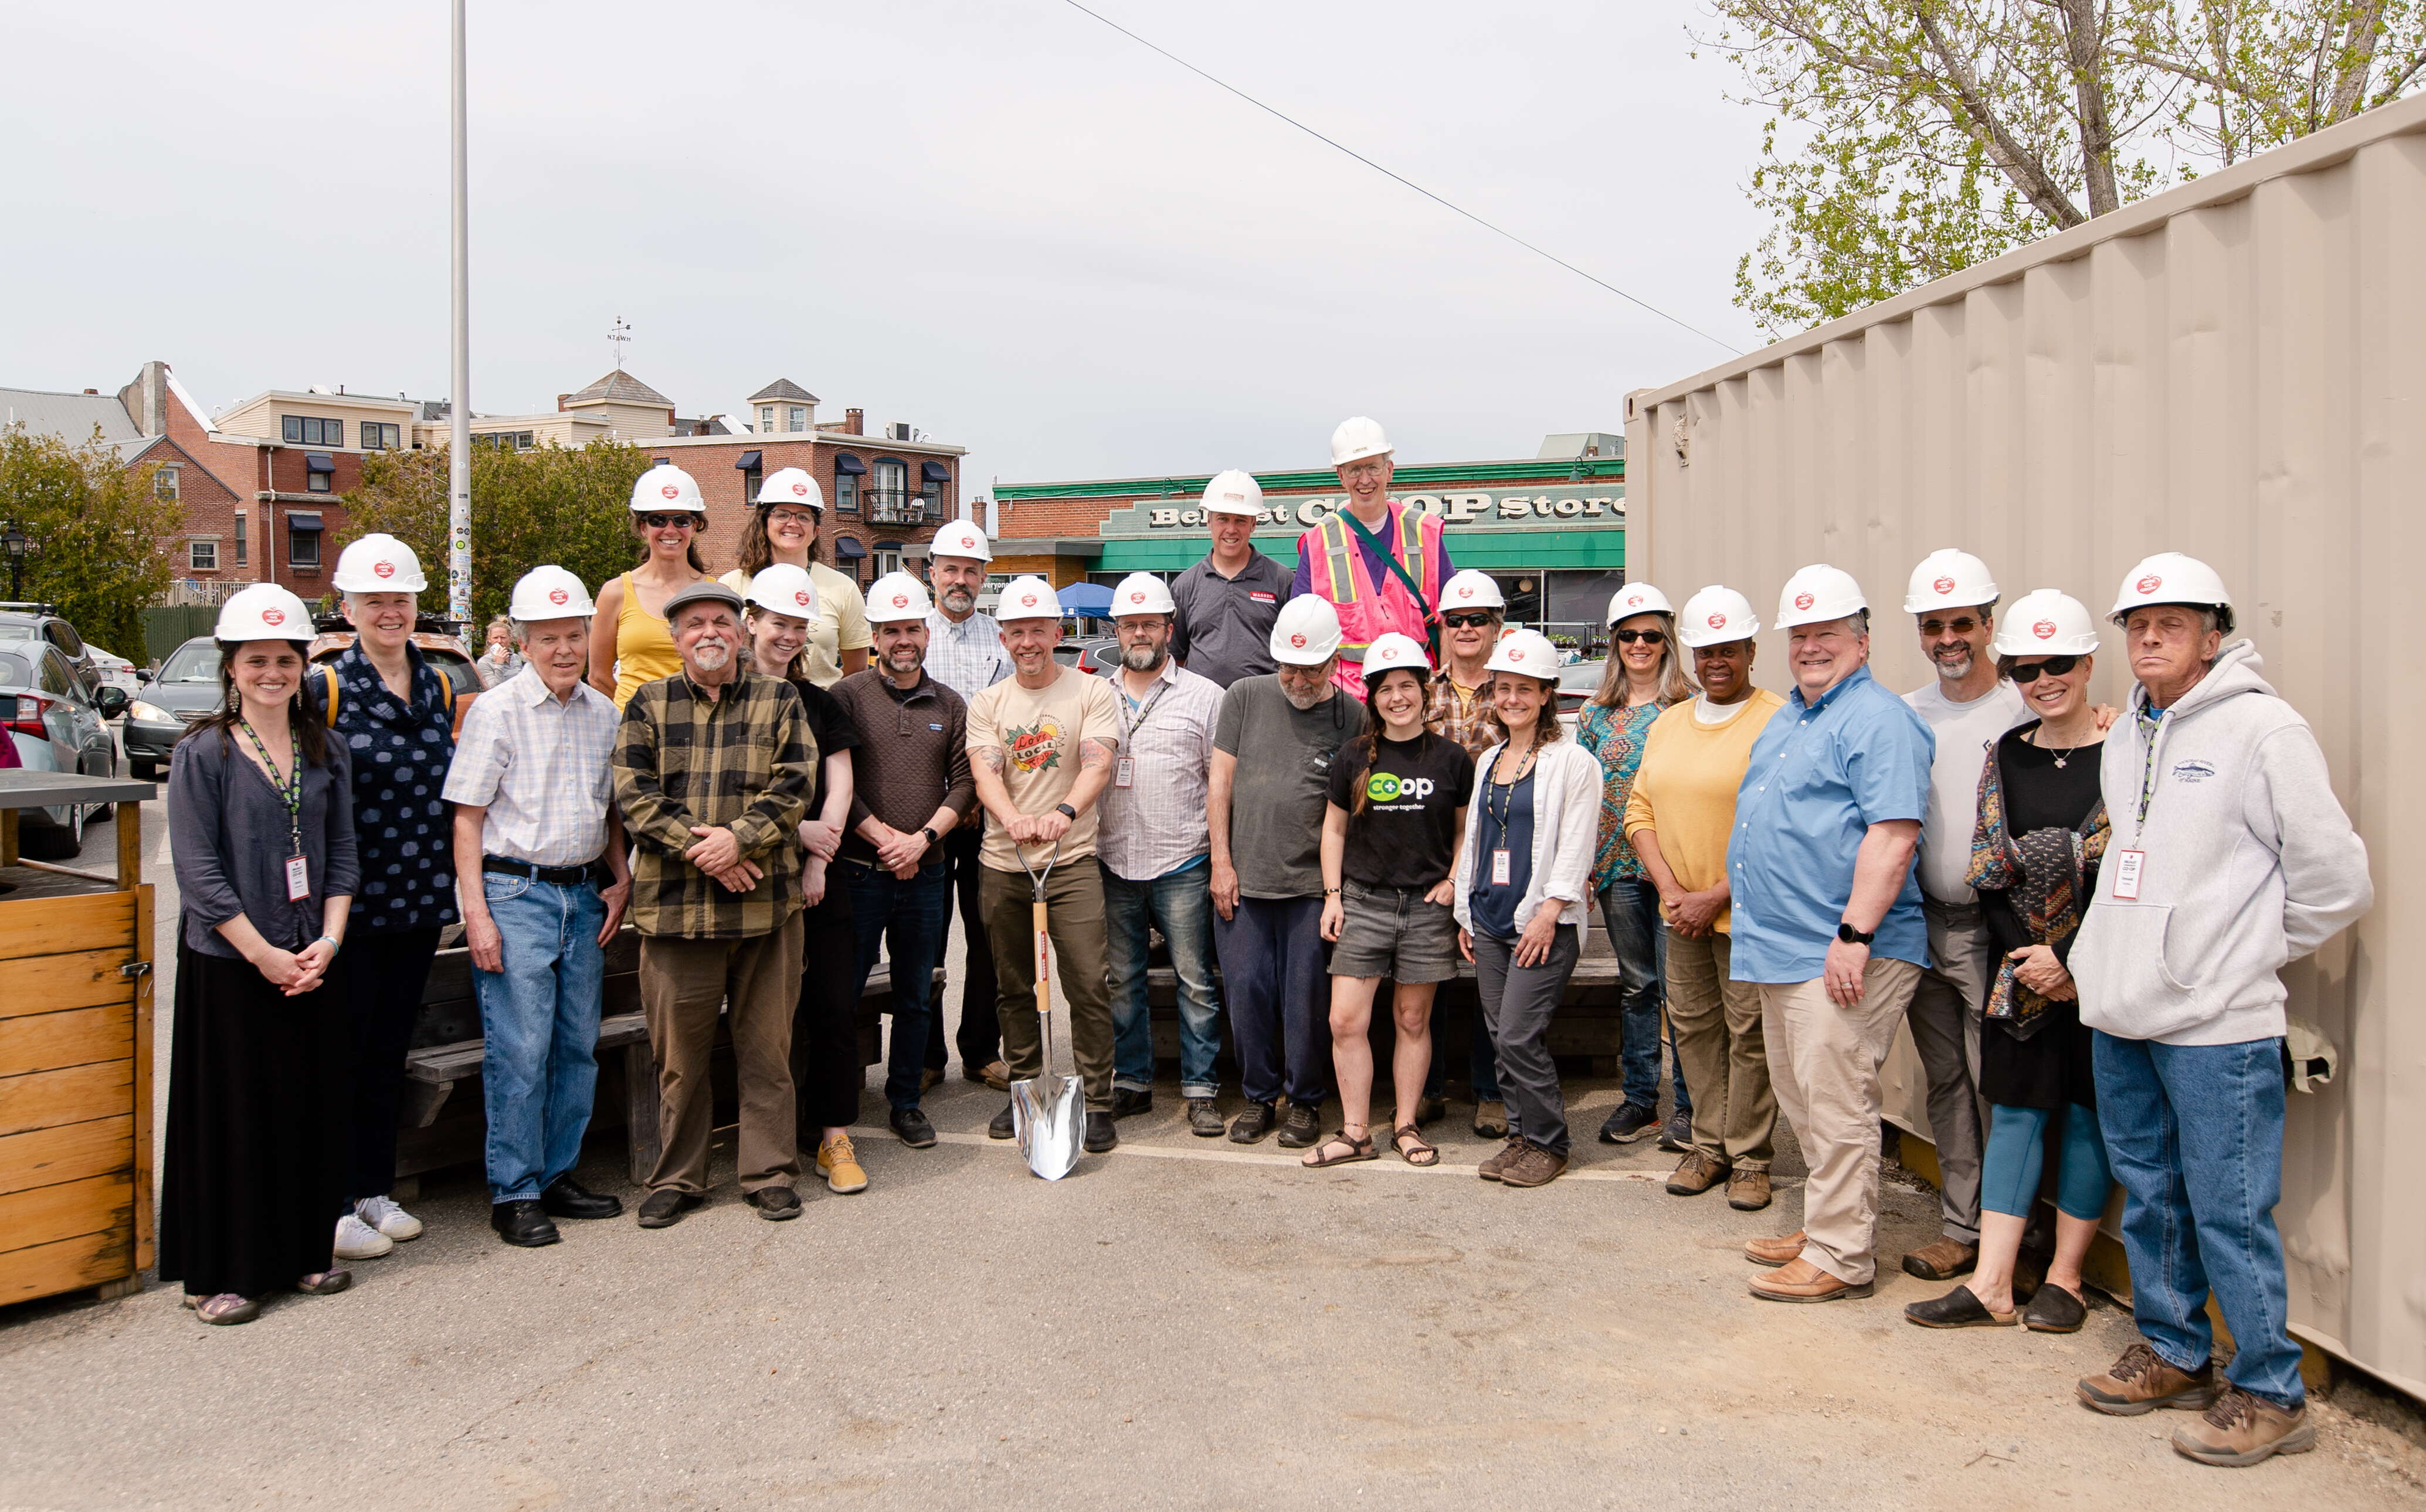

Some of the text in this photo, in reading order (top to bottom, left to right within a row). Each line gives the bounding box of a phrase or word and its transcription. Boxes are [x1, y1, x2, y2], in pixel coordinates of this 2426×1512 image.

[1149, 505, 1290, 528] Belst
[1497, 495, 1626, 519] Stor
[1018, 734, 1047, 748] Love
[1400, 803, 1426, 811] together
